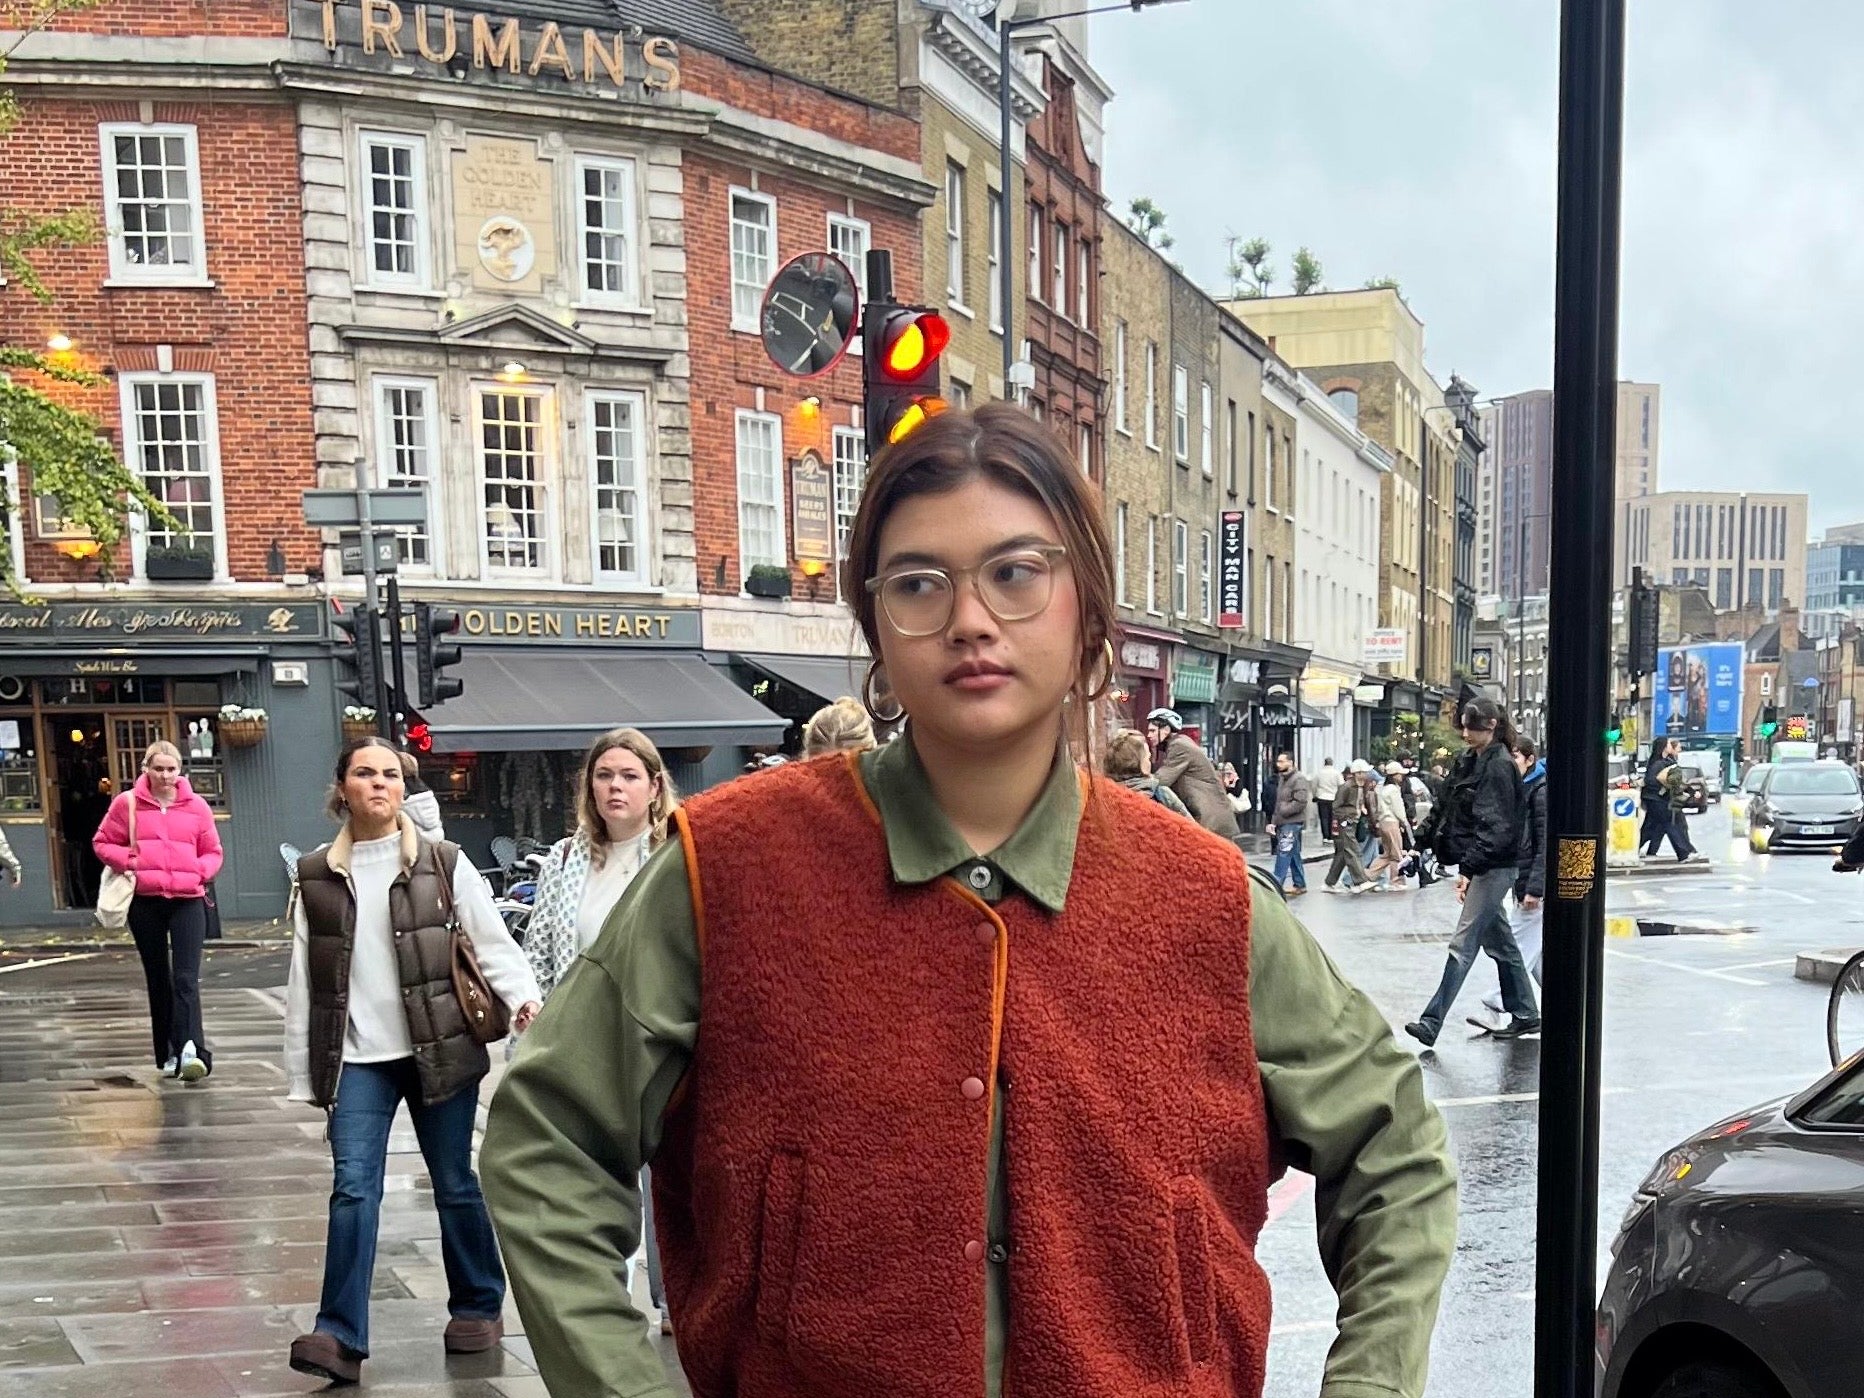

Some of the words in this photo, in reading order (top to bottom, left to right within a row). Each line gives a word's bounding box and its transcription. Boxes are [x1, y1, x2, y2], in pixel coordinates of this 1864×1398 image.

[320, 0, 681, 92] TRUMAN'S
[481, 146, 520, 165] THE
[462, 166, 541, 189] GOLDEN
[470, 189, 536, 212] HEART
[1225, 523, 1240, 554] CITY
[1224, 558, 1241, 581] MAN
[464, 609, 562, 636] OLDEN
[576, 613, 671, 638] HEART
